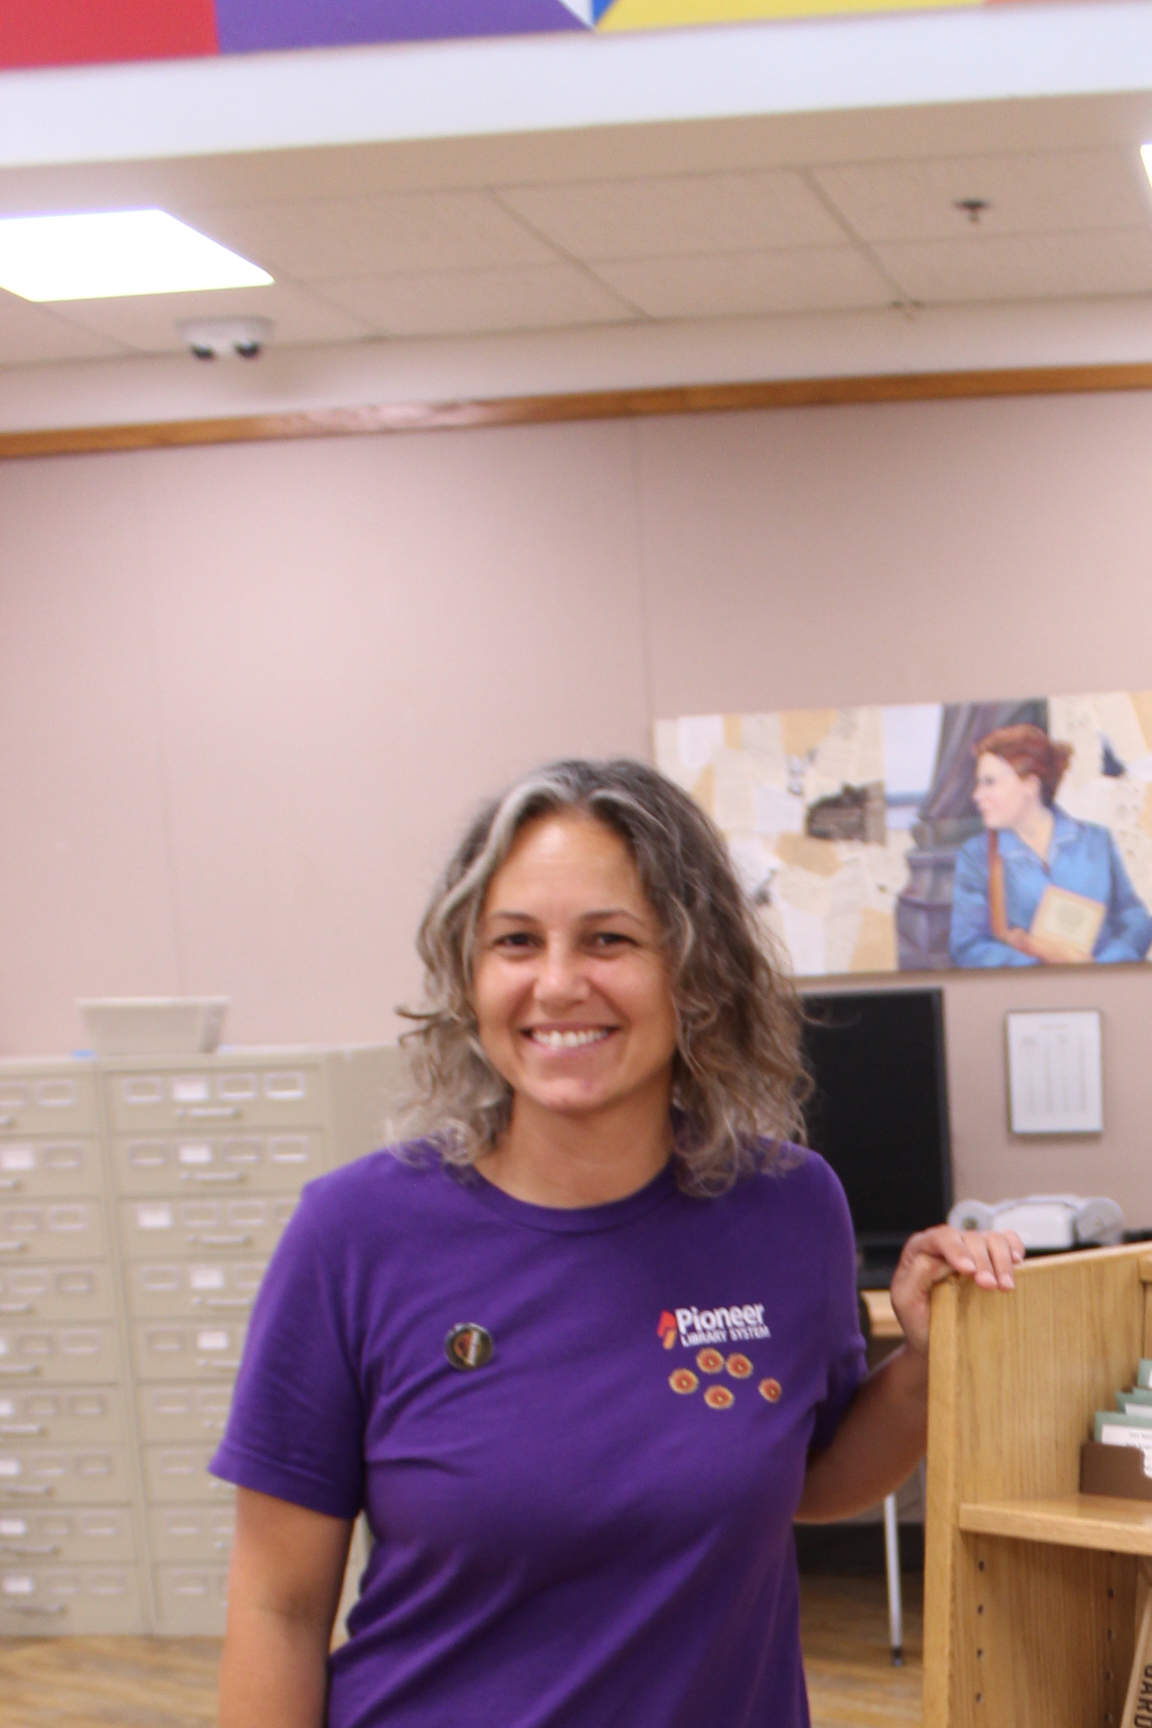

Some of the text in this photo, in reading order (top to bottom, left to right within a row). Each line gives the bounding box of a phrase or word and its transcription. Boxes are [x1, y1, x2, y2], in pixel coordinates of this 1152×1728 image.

[675, 1303, 766, 1335] Pioneer
[681, 1323, 771, 1347] LIBRARY SYSTEM
